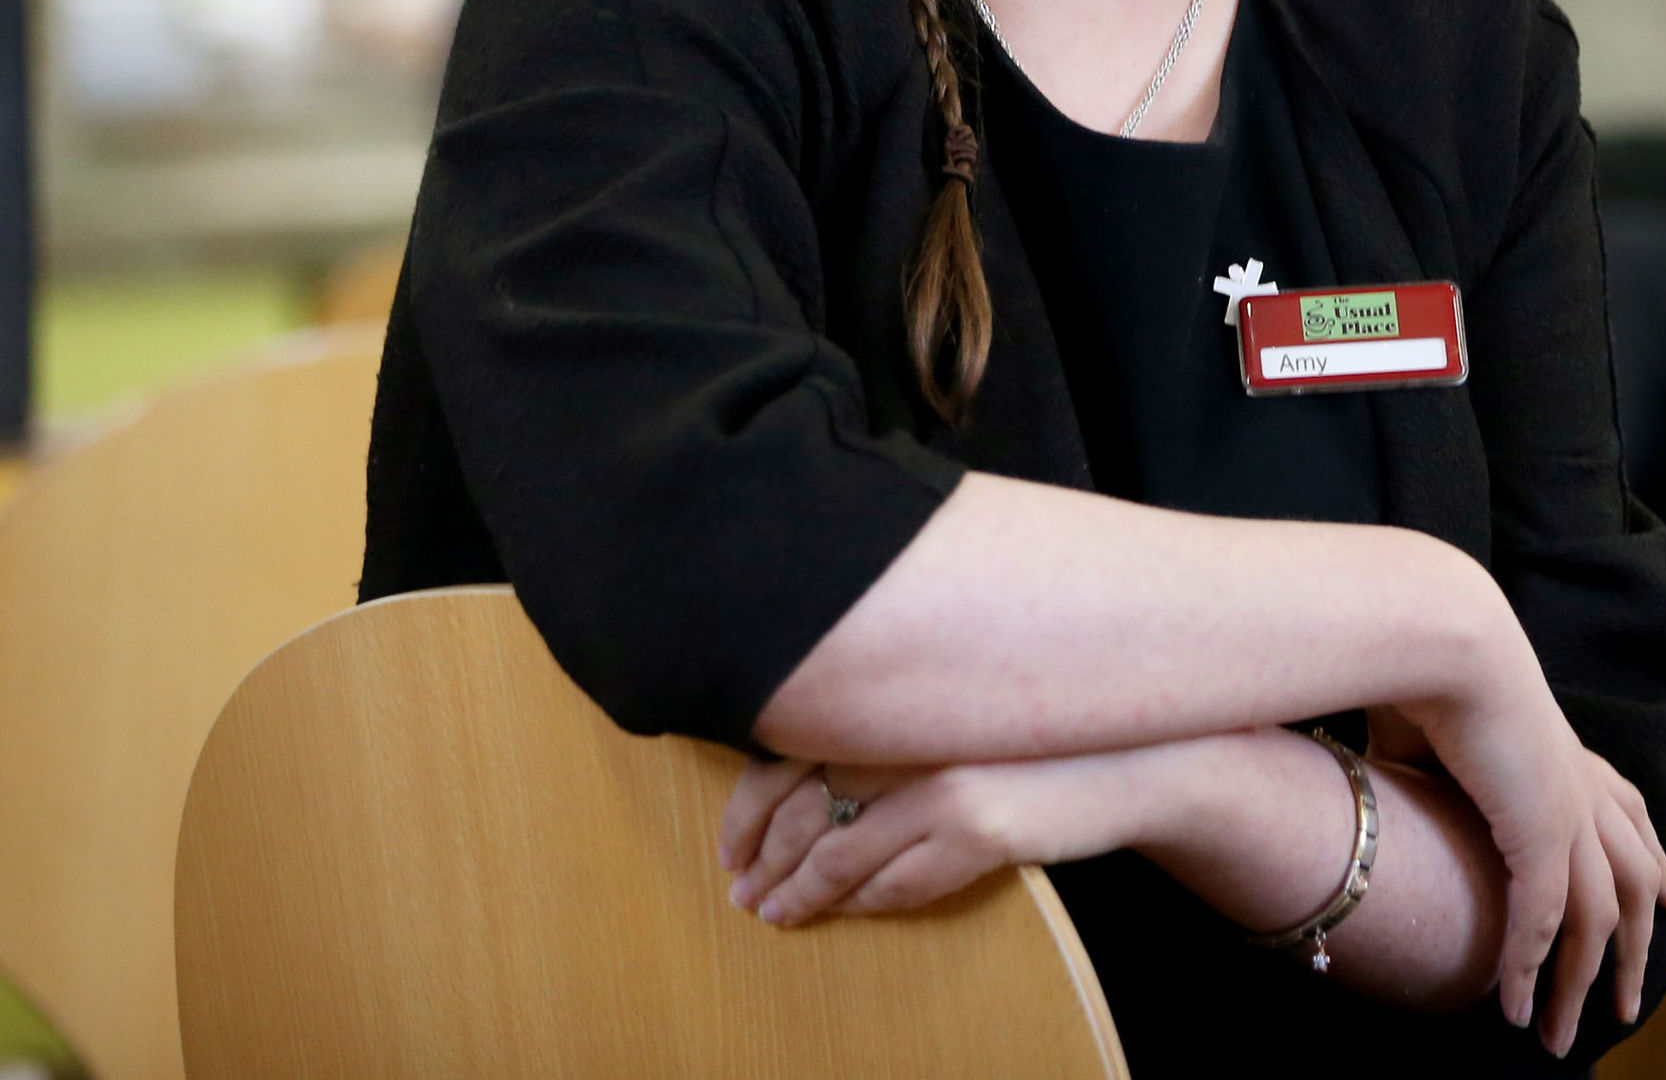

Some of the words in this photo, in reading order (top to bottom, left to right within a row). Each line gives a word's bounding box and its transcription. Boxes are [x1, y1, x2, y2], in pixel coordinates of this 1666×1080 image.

[1333, 296, 1350, 304] The
[1334, 303, 1391, 319] Usual
[1341, 321, 1396, 335] Place
[1280, 353, 1328, 375] Amy
